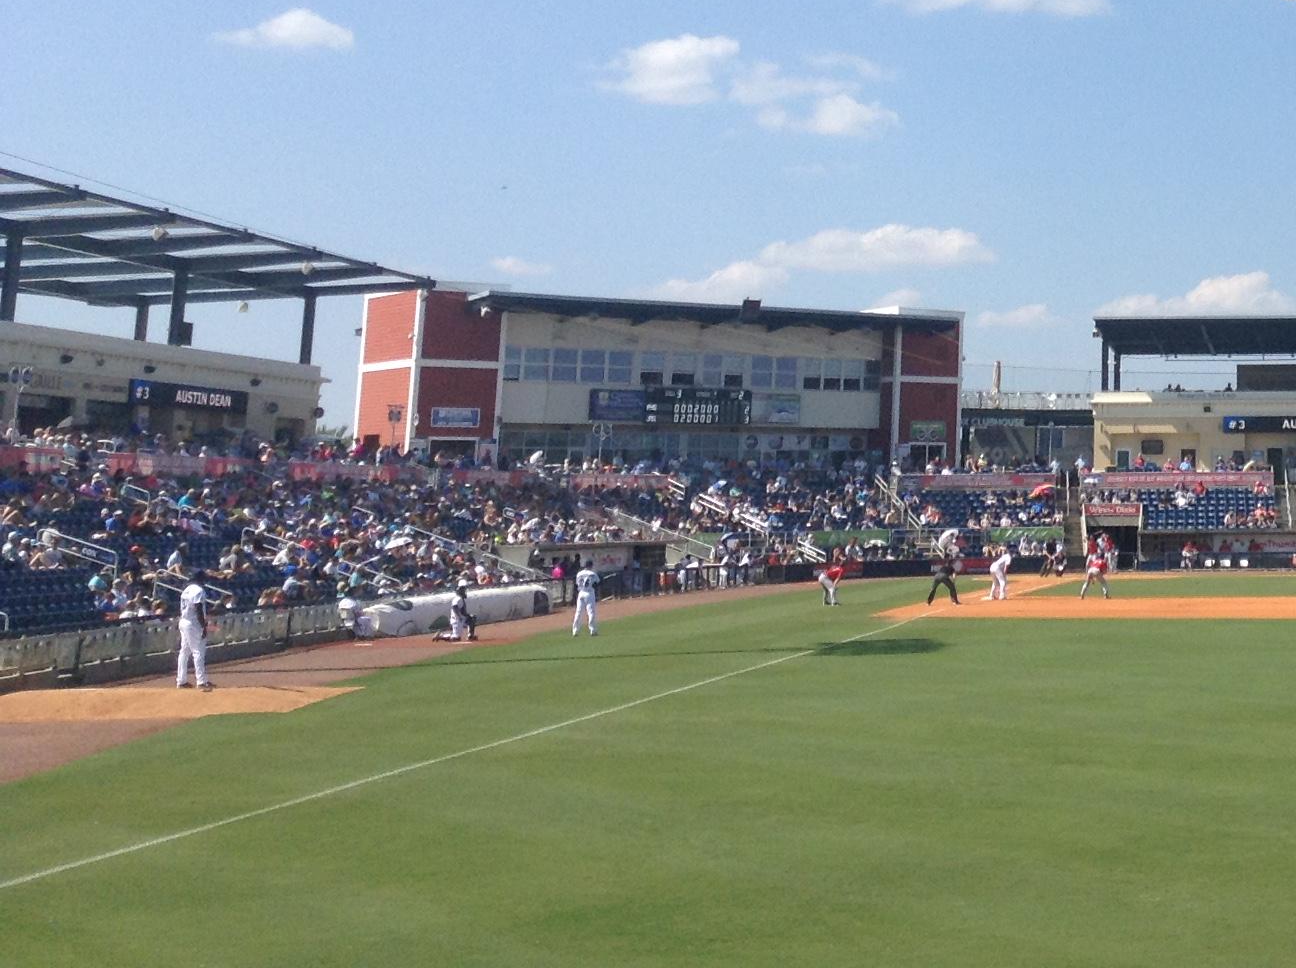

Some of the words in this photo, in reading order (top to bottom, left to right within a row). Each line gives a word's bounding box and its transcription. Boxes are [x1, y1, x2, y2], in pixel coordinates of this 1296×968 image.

[135, 386, 150, 400] #3
[175, 389, 208, 405] AUSTIN
[209, 393, 232, 407] DEAN
[1228, 420, 1246, 430] #3
